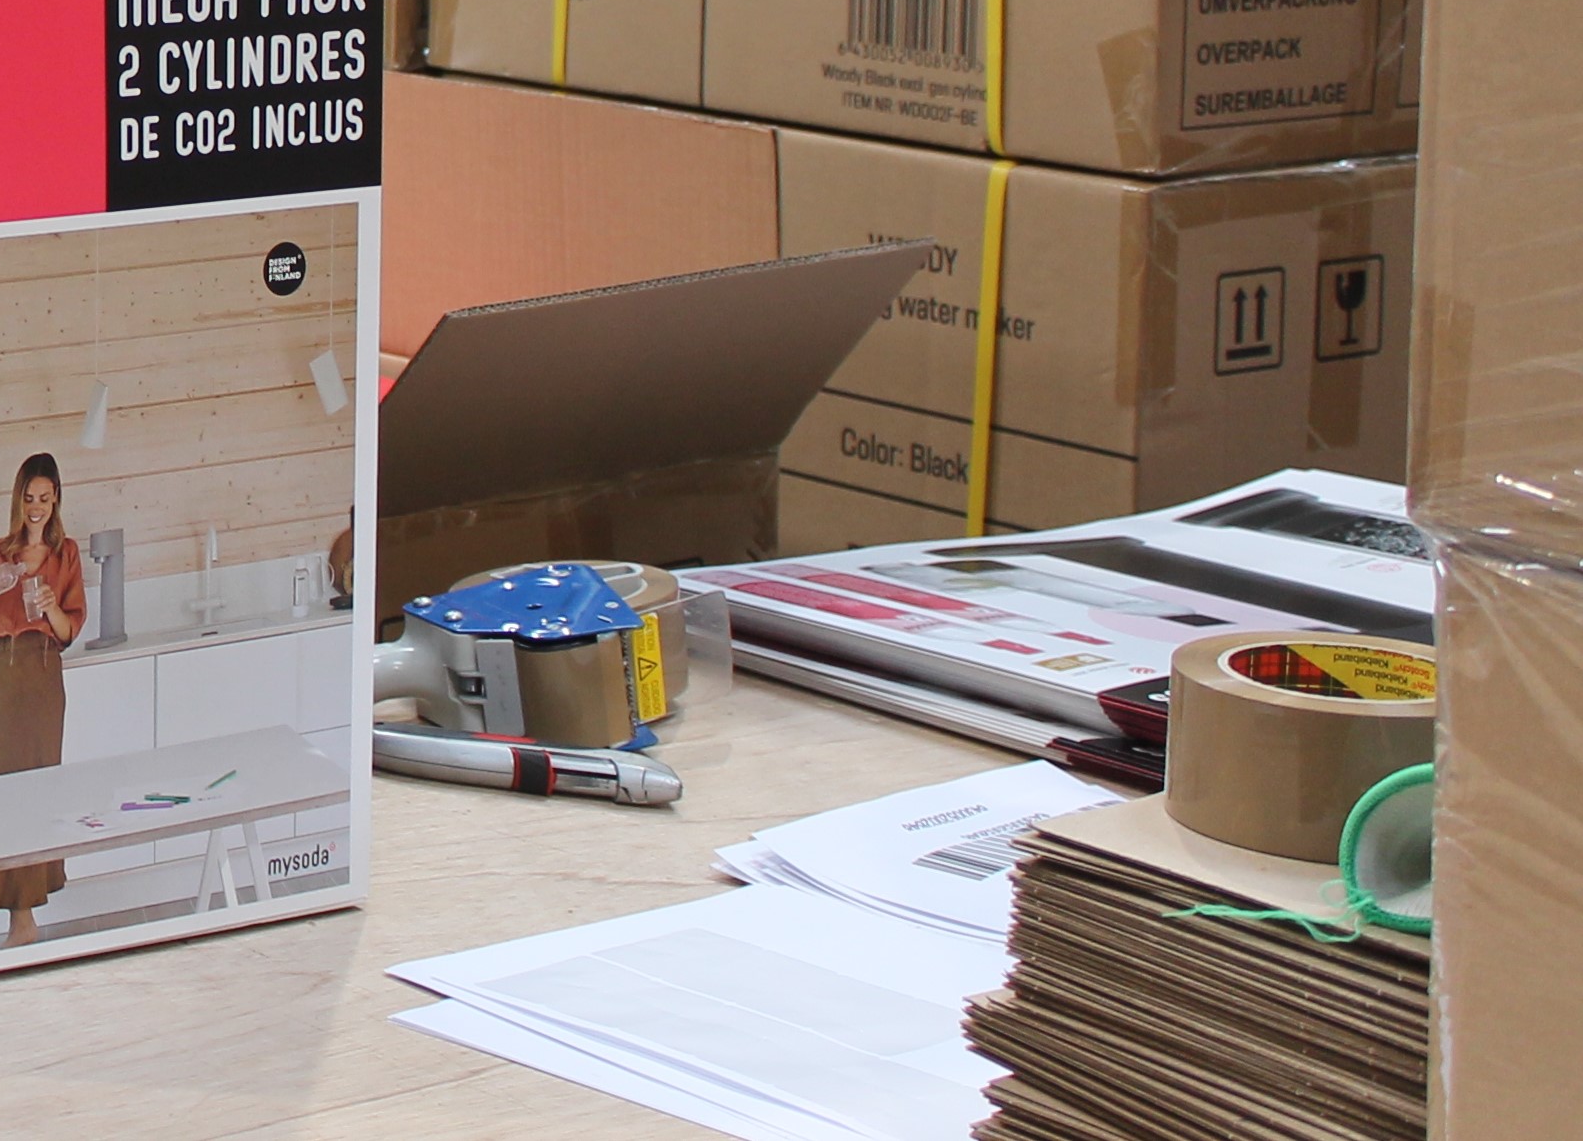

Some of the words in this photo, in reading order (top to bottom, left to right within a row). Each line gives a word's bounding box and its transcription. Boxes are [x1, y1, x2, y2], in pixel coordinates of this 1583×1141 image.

[118, 45, 141, 97] 2
[158, 28, 366, 94] CYLINDRES
[1197, 37, 1303, 66] OVERPACK
[1195, 82, 1348, 116] SUREMBALLAGE
[120, 115, 160, 161] DE
[175, 108, 236, 157] CO2
[252, 98, 364, 150] INCLUS
[898, 296, 960, 325] water
[841, 427, 903, 466] Color:
[910, 443, 969, 485] Black
[1333, 652, 1389, 669] Klebeband
[1354, 667, 1408, 687] Klebeband
[268, 844, 330, 877] mysoda
